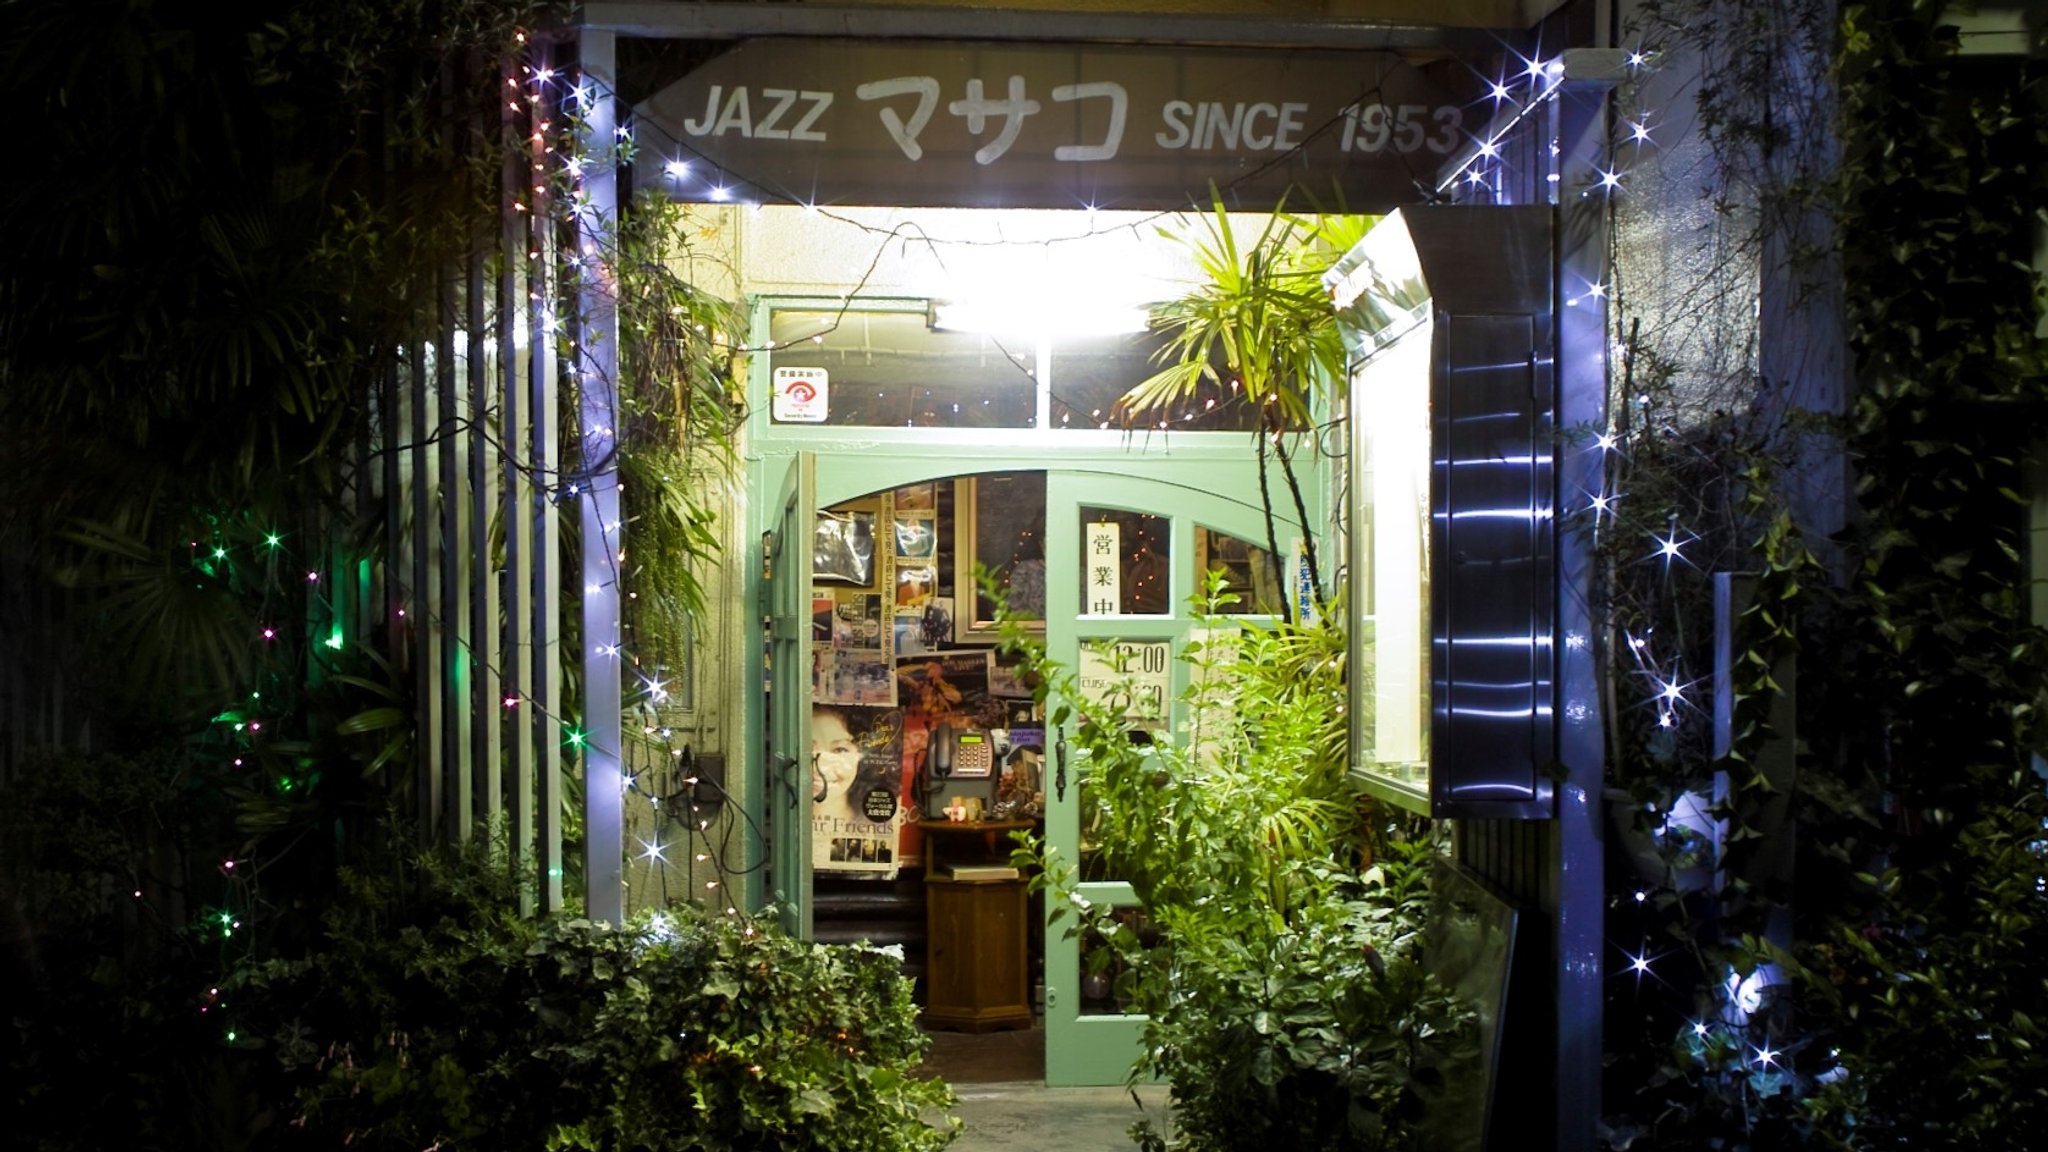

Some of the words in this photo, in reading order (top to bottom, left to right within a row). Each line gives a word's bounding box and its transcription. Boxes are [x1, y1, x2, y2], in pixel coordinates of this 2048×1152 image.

[684, 85, 835, 143] JAZZ
[856, 74, 1128, 166] マサコ
[1156, 99, 1309, 153] SINCE
[1339, 103, 1463, 156] 1953
[1094, 534, 1114, 615] 営業中
[1114, 645, 1165, 674] 12:00
[833, 817, 895, 835] Friends
